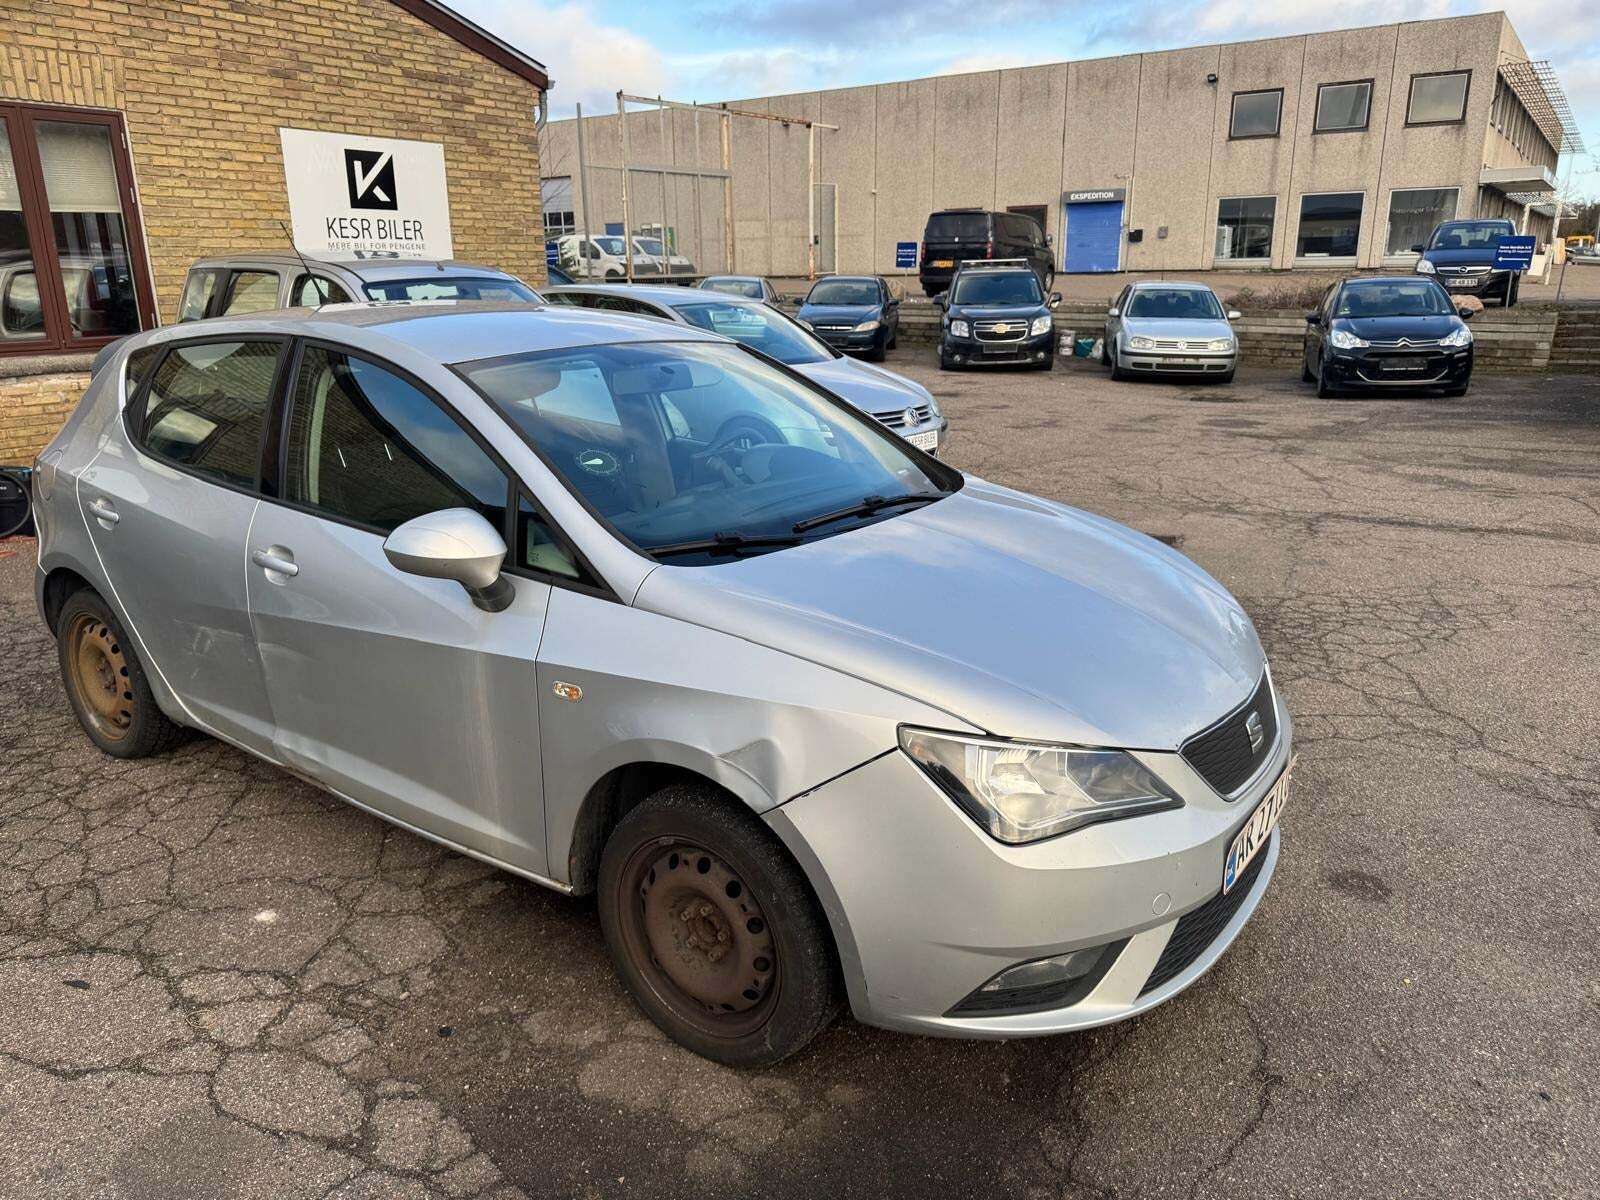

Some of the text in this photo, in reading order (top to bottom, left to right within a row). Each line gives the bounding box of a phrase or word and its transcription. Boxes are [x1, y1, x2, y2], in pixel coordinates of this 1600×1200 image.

[1070, 191, 1114, 200] EKSPEDITION
[326, 216, 424, 241] KESR BILER
[327, 242, 426, 251] MERE BIL FOR PENGENE
[1257, 795, 1275, 844] 27
